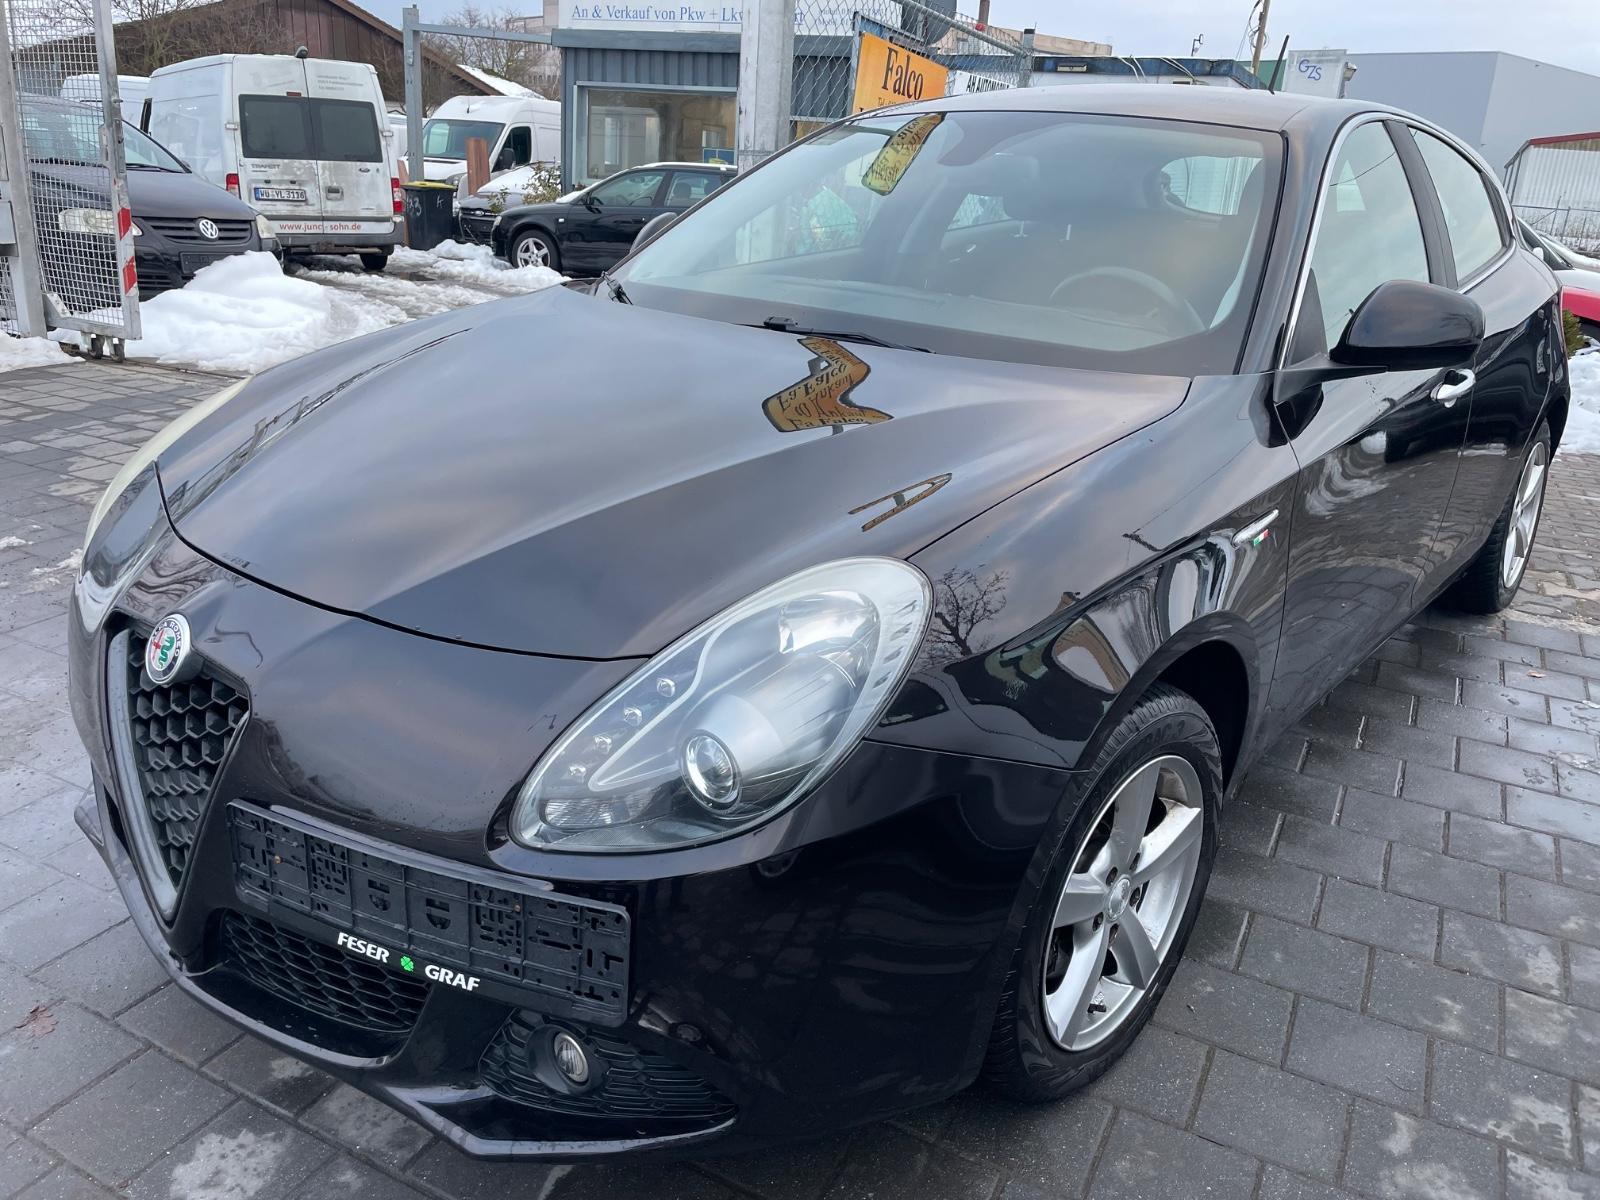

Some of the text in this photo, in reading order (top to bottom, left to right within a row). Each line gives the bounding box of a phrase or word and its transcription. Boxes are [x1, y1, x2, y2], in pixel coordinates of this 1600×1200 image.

[572, 4, 588, 19] An
[592, 4, 601, 19] &
[607, 5, 652, 20] Verkauf
[654, 9, 676, 21] von
[680, 6, 706, 21] Pkw
[709, 9, 719, 20] +
[882, 46, 924, 101] Falco
[1298, 59, 1322, 81] GZS
[169, 622, 181, 656] ROMEO
[337, 931, 481, 991] FESER GRAF
